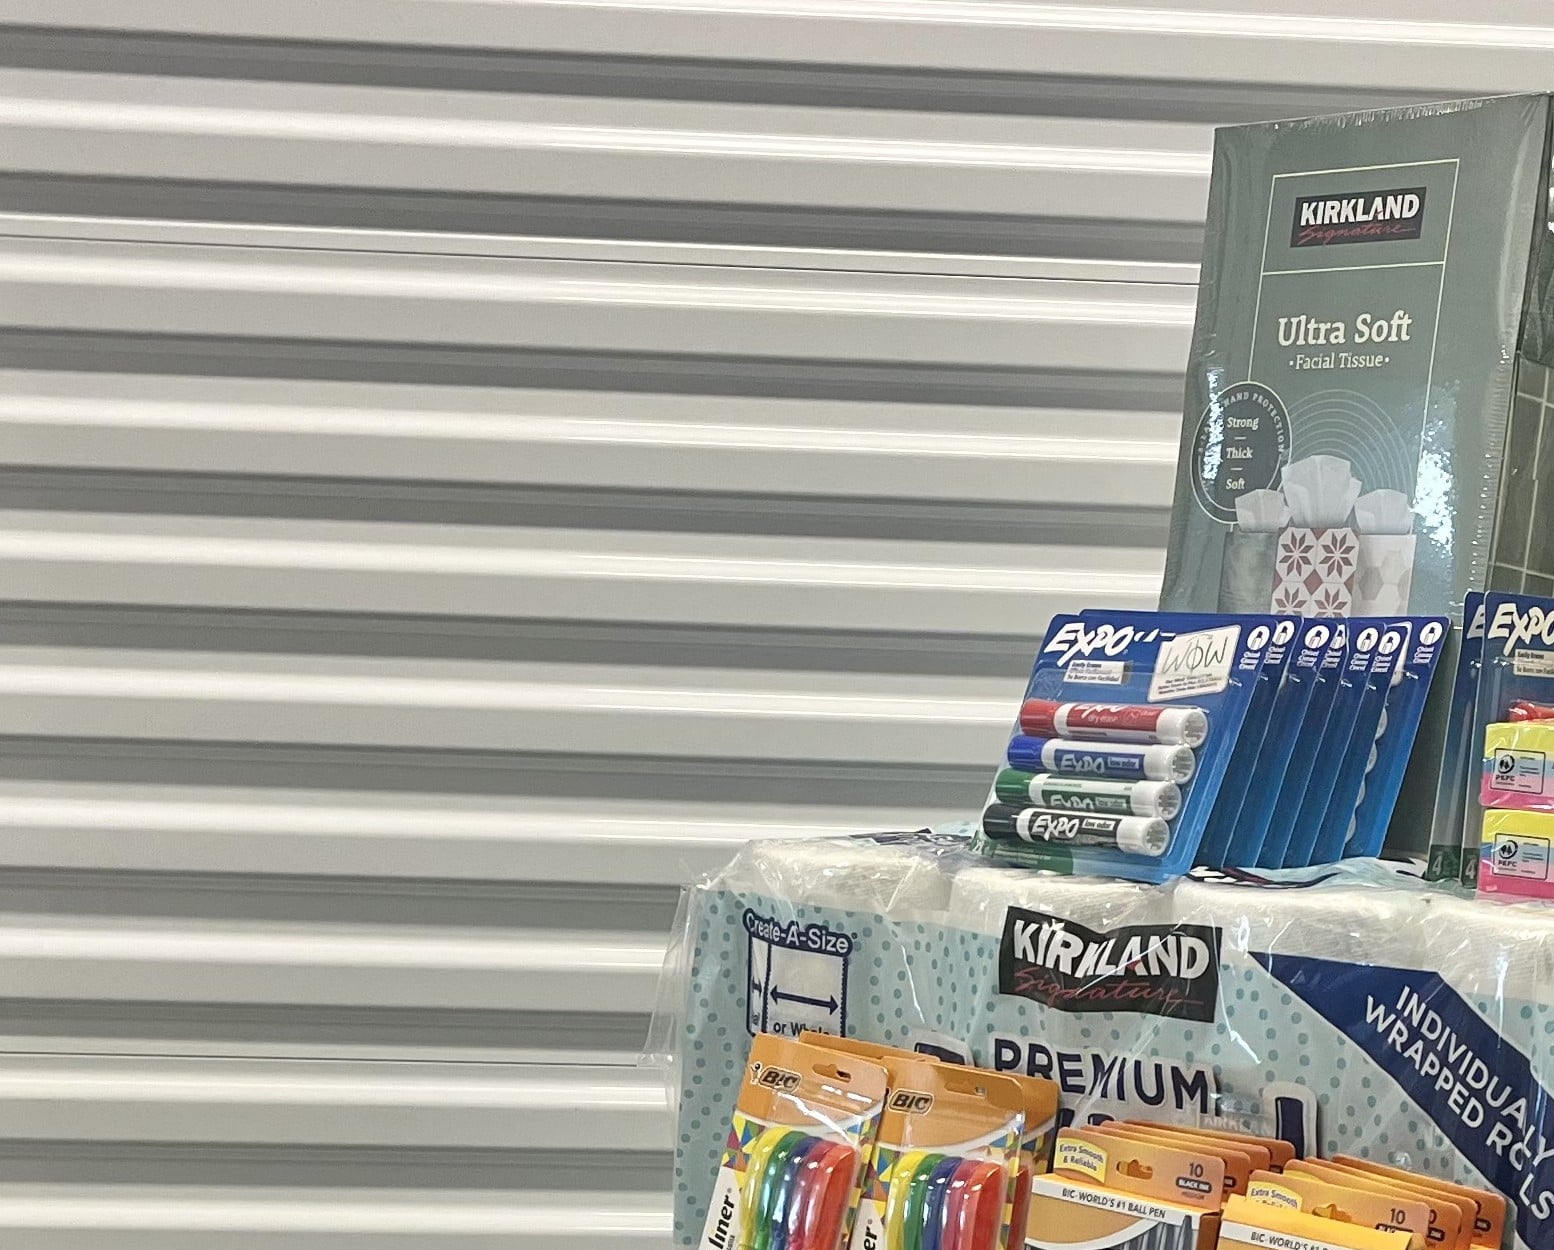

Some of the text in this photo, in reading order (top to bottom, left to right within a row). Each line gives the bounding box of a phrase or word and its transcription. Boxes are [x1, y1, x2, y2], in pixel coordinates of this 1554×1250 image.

[1300, 194, 1420, 226] KIRKLAND
[1277, 309, 1413, 346] Ultra Soft
[1296, 352, 1384, 369] Facial Tissue
[1227, 417, 1260, 431] Strong
[1252, 392, 1286, 454] PROTECTION
[1226, 446, 1254, 459] Thick
[1225, 478, 1246, 490] Soft
[1044, 623, 1134, 668] EXPO
[1032, 815, 1079, 841] EXPO
[773, 1022, 786, 1034] or
[1366, 995, 1484, 1128] WRAPPED
[762, 1070, 799, 1091] BIC
[892, 1092, 931, 1110] BIC
[1060, 1144, 1105, 1164] Extra Smooth
[1189, 1161, 1204, 1178] 10
[1179, 1179, 1199, 1189] BLACK
[1251, 1188, 1271, 1198] Extra
[1062, 1188, 1166, 1219] BIC WORLD'S #1 BALL PEN
[709, 1194, 736, 1250] liner
[1390, 1208, 1406, 1225] 10
[1251, 1232, 1265, 1243] BIC
